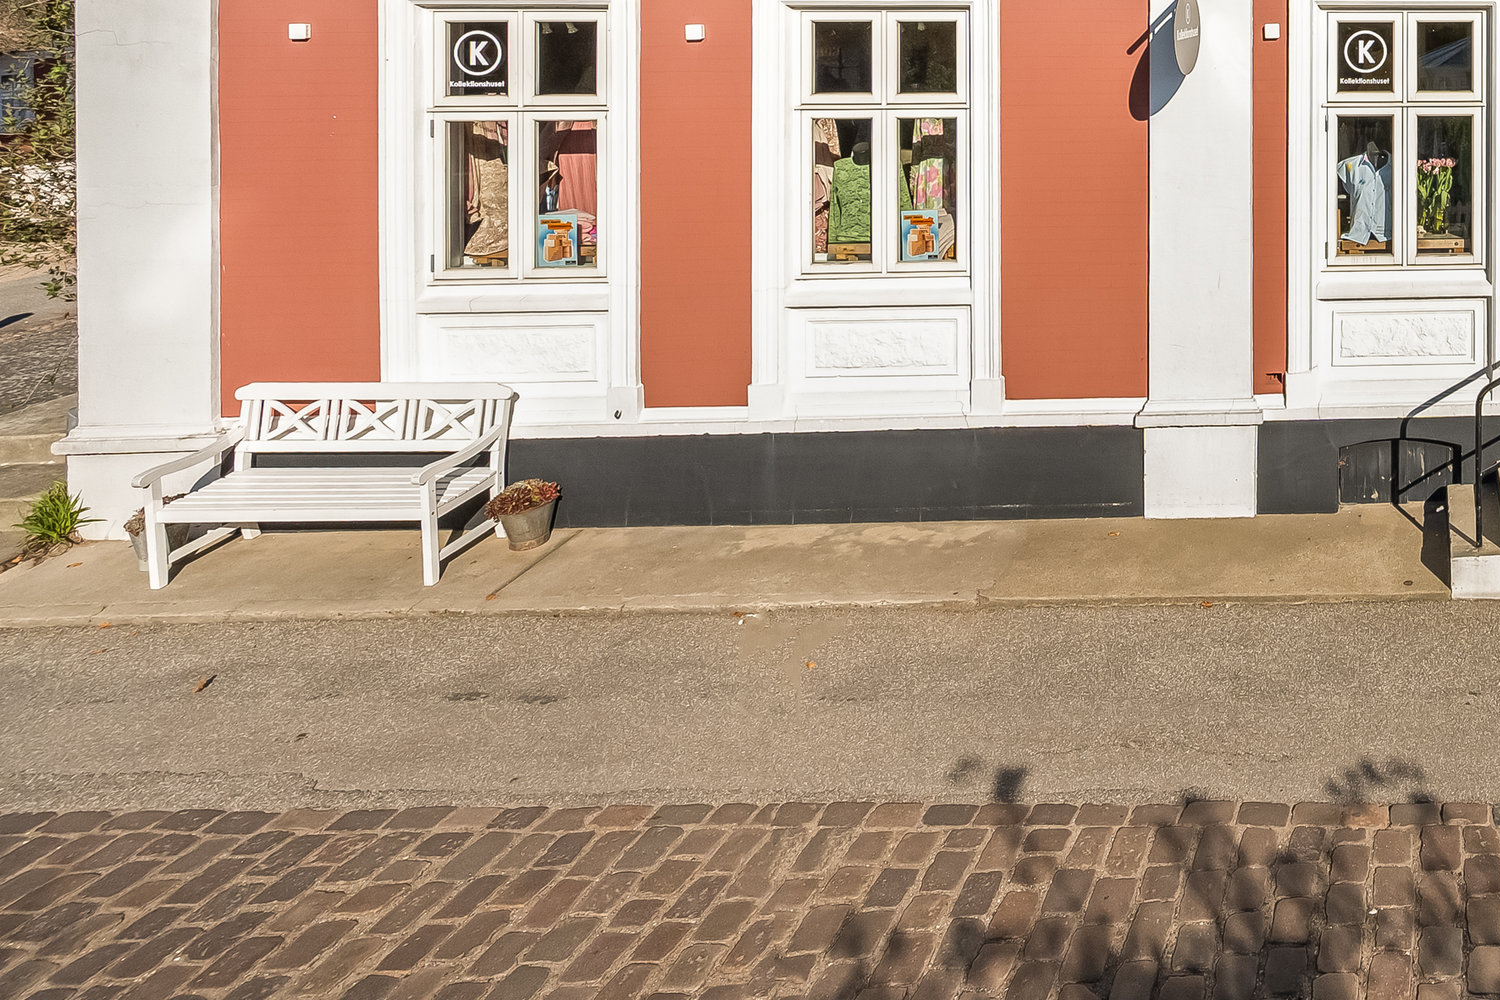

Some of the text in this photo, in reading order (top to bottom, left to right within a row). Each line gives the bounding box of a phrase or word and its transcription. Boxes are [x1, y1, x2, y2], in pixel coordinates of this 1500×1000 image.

[469, 40, 489, 66] K
[1358, 39, 1376, 65] K
[1339, 77, 1390, 85] Kollektionshuset
